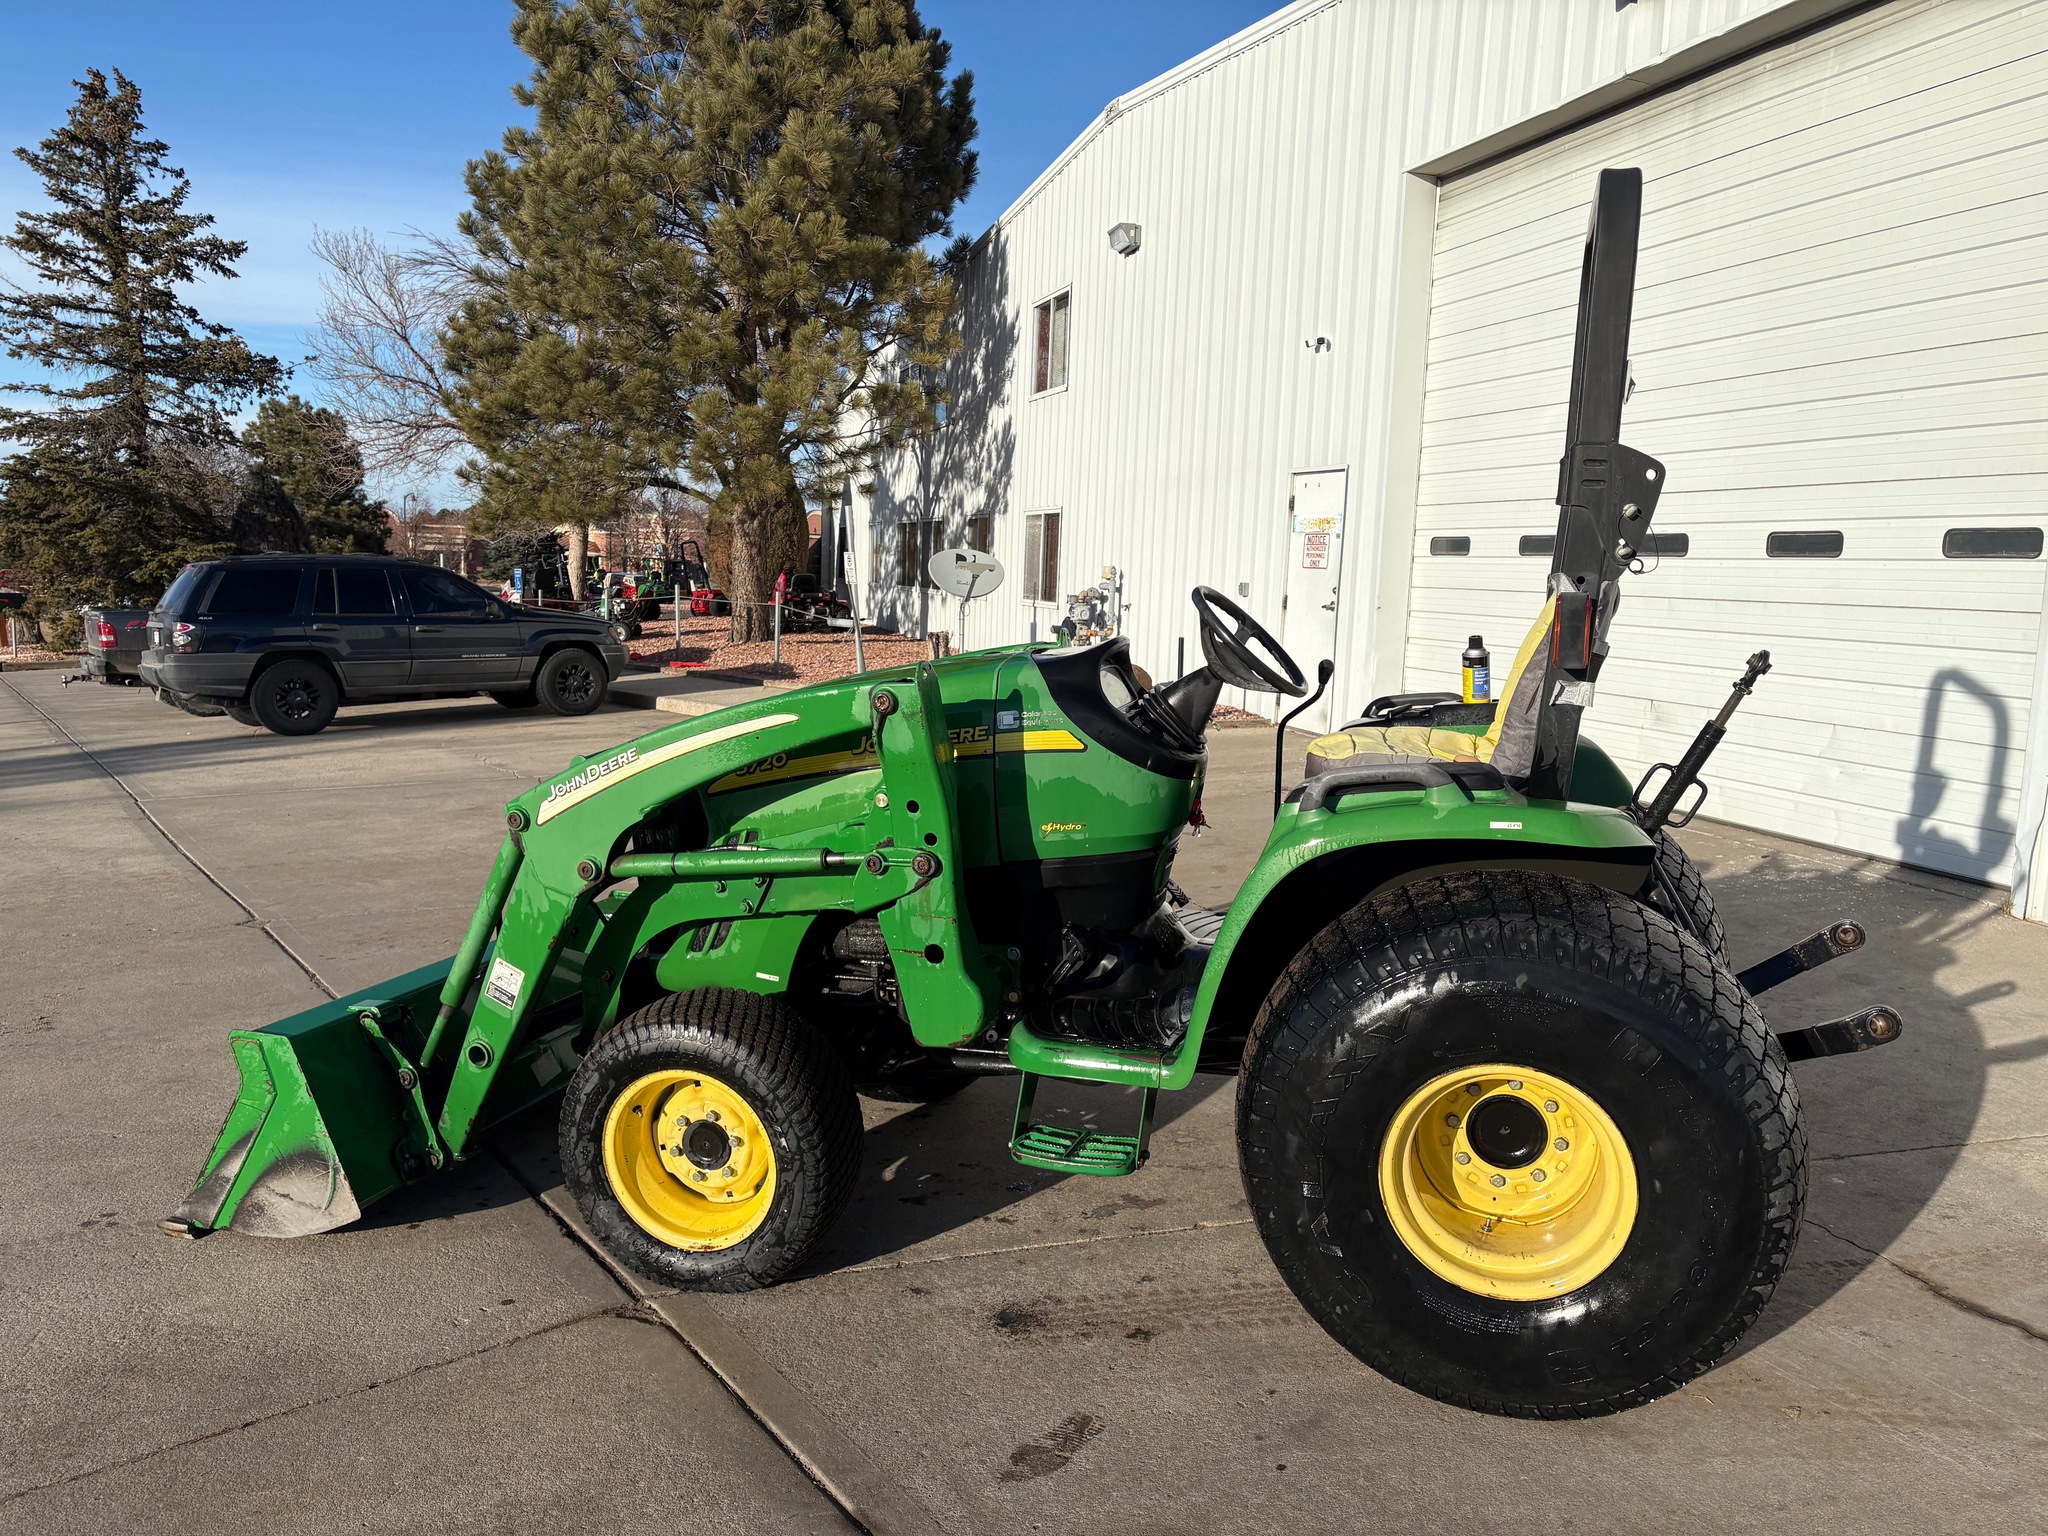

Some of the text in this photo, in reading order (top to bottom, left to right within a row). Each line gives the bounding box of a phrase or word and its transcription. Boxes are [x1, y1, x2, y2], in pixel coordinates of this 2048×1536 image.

[1307, 535, 1327, 545] NOTICE
[1309, 559, 1321, 567] ONLY
[547, 747, 640, 802] JOHN DEERE
